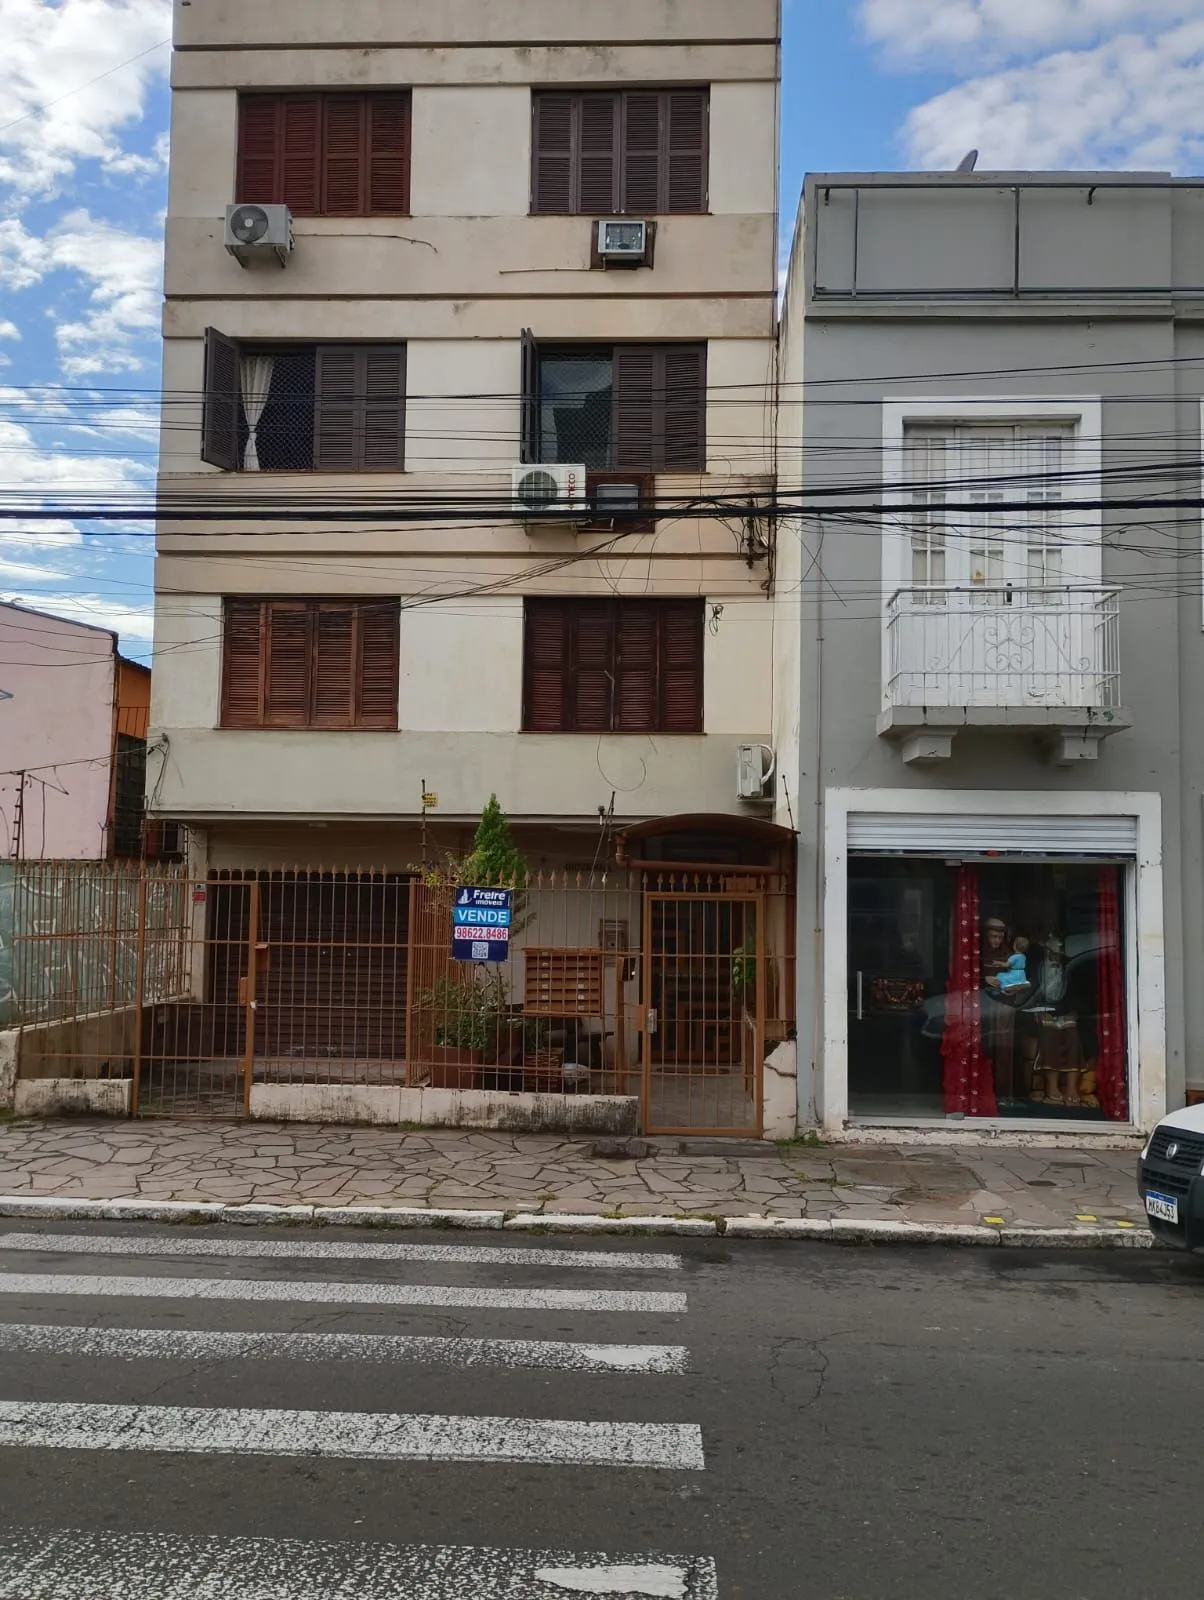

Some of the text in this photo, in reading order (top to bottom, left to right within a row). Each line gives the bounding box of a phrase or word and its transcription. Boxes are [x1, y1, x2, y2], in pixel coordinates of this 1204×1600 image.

[473, 889, 506, 900] Freire
[458, 909, 507, 923] VENDE
[456, 927, 507, 939] 98622.8486
